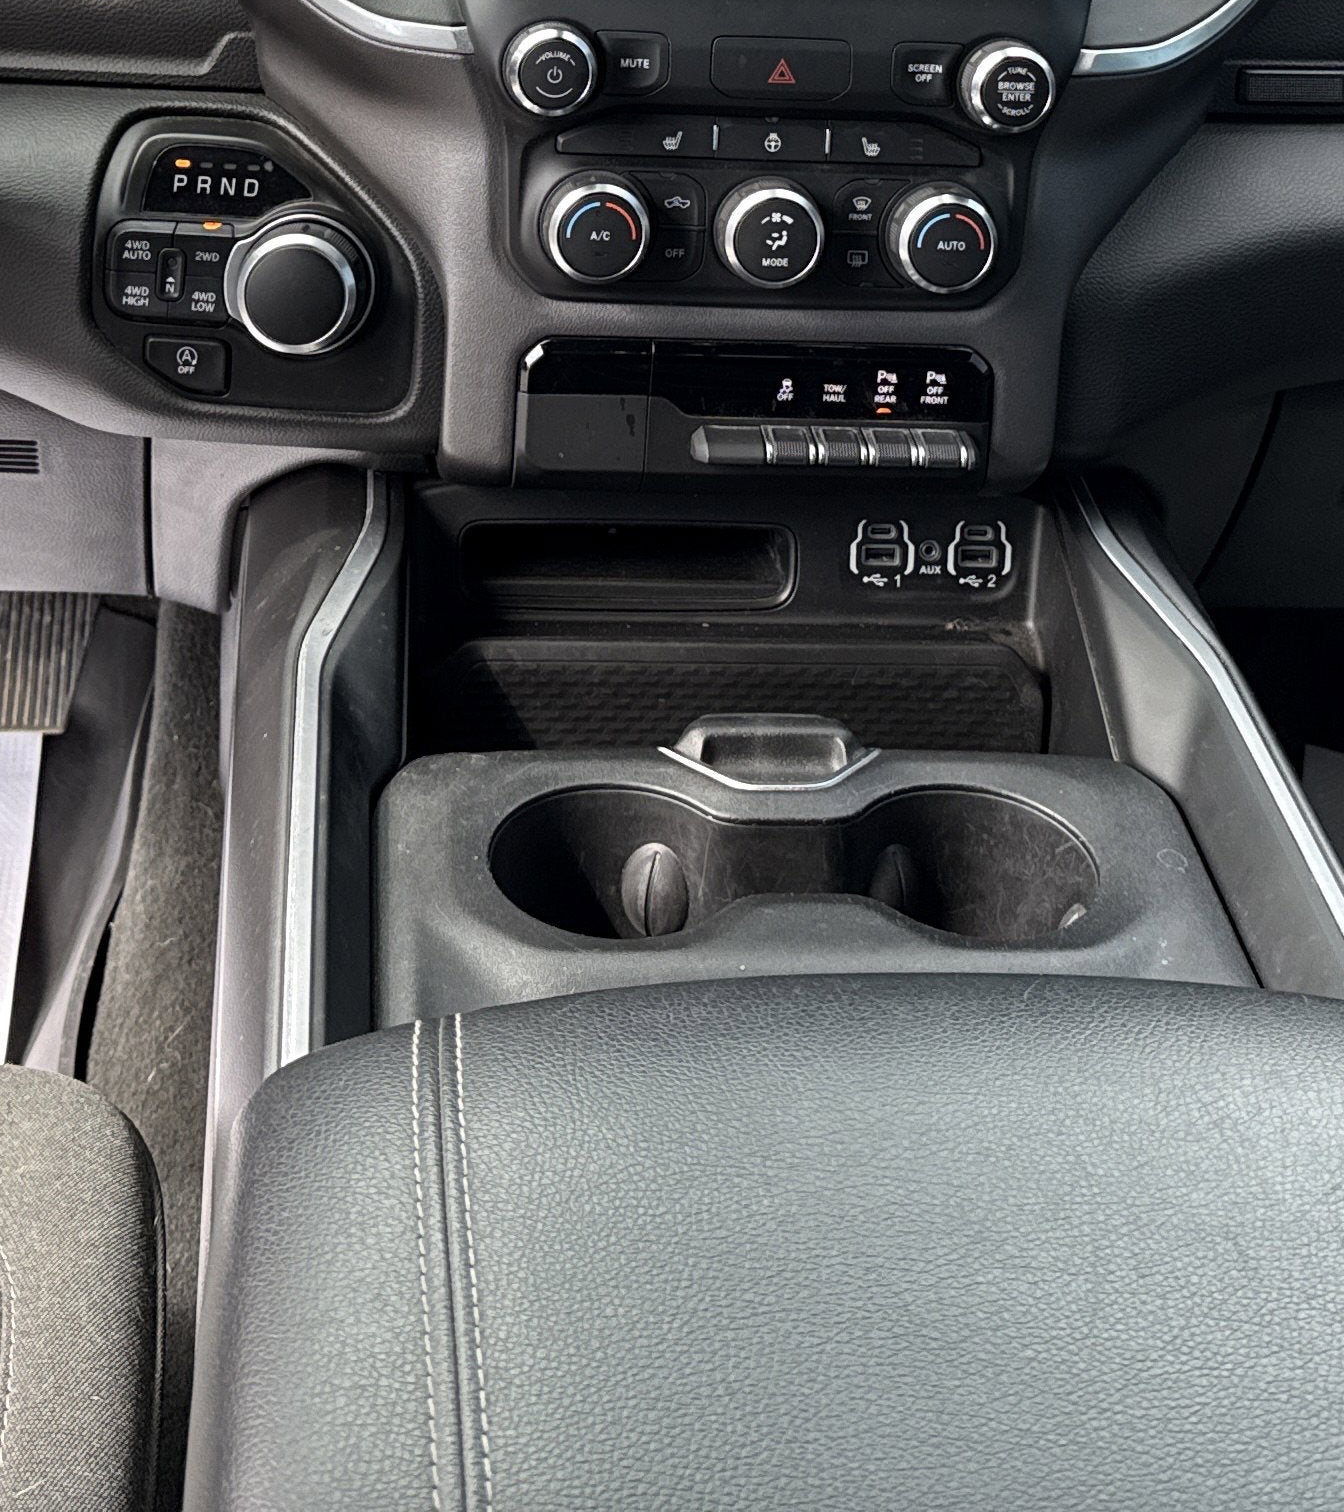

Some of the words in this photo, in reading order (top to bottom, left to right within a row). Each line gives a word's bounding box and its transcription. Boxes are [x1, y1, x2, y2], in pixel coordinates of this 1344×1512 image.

[541, 50, 571, 62] VOLUME
[620, 58, 650, 69] MUTE
[907, 63, 943, 74] SCREEN
[1007, 67, 1029, 76] TUNE
[915, 73, 933, 83] OFF
[997, 81, 1036, 91] BROWSE
[1002, 92, 1032, 102] ENTER
[1002, 106, 1032, 117] SCROLL
[173, 174, 188, 193] P
[196, 176, 212, 195] R
[220, 177, 237, 196] N
[243, 178, 260, 198] D
[848, 213, 873, 221] FRONT
[589, 230, 611, 242] A/C
[125, 240, 151, 250] 4WD
[937, 240, 966, 251] AUTO
[123, 250, 152, 261] AUTO
[195, 251, 220, 262] 2WD
[665, 248, 686, 259] OFF
[761, 257, 790, 267] MODE
[124, 285, 150, 297] 4WD
[122, 296, 149, 307] HIGH
[191, 291, 217, 302] 4WD
[191, 302, 216, 313] LOW
[177, 365, 196, 375] OFF
[823, 383, 848, 393] TOW/
[877, 385, 896, 394] OFF
[926, 386, 945, 396] OFF
[776, 392, 795, 402] OFF
[822, 393, 847, 403] HAUL
[874, 394, 897, 404] REAR
[920, 396, 950, 405] FRONT
[919, 565, 942, 575] AUX
[894, 574, 902, 588] 1
[986, 574, 997, 588] 2
